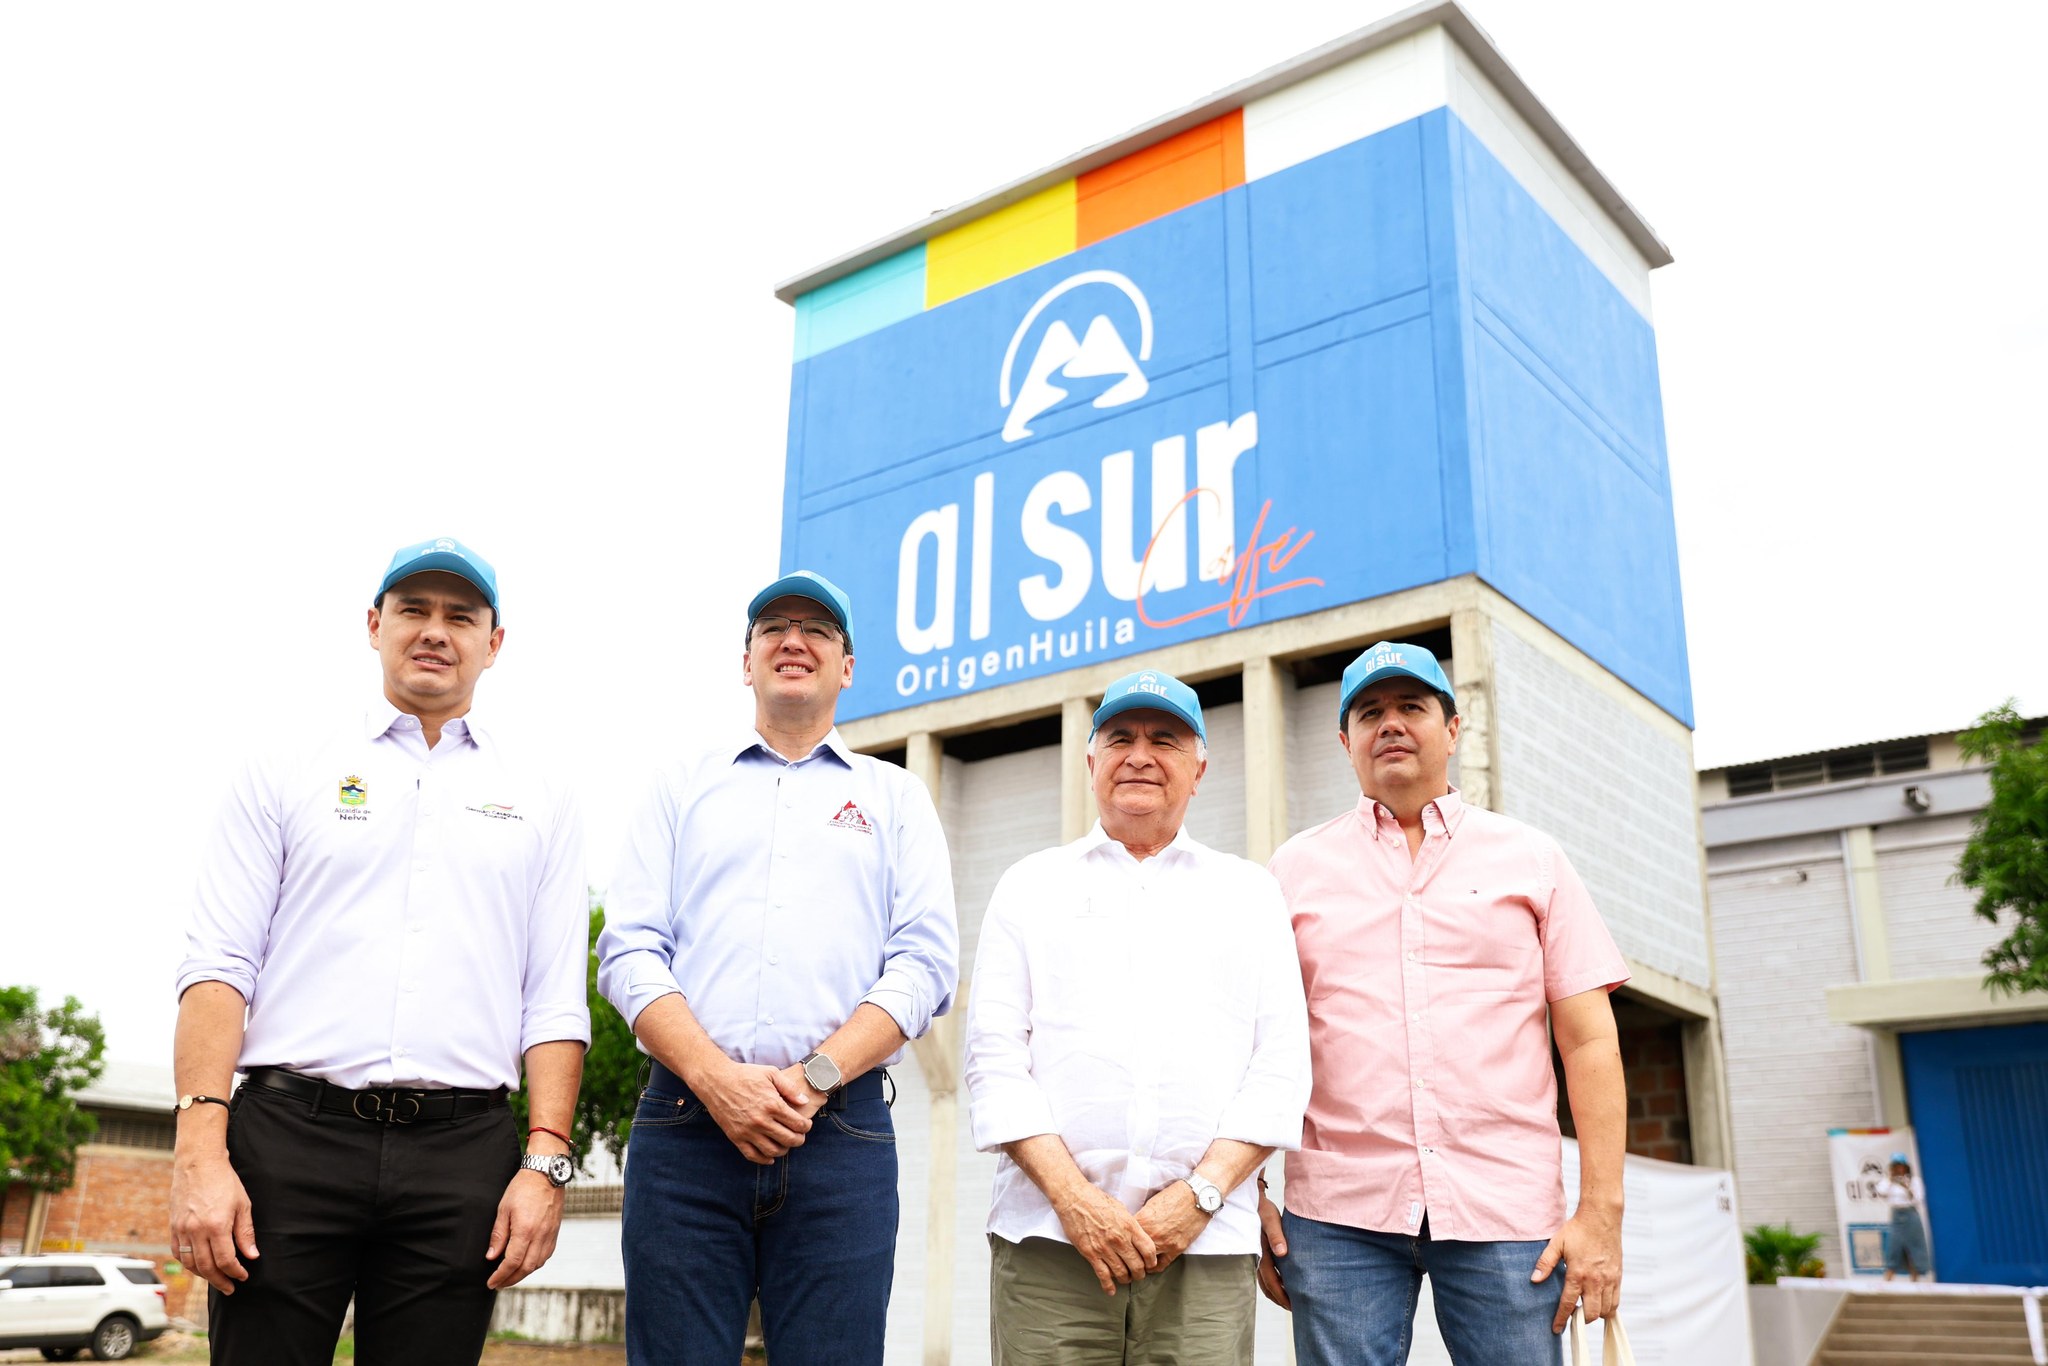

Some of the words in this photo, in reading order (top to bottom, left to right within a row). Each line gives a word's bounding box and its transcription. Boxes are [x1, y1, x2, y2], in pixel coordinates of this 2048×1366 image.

[895, 472, 994, 656] al
[1018, 411, 1258, 622] sur
[1365, 656, 1376, 673] al
[1376, 652, 1404, 667] sur
[1140, 683, 1169, 697] sur
[339, 813, 368, 821] Neiva
